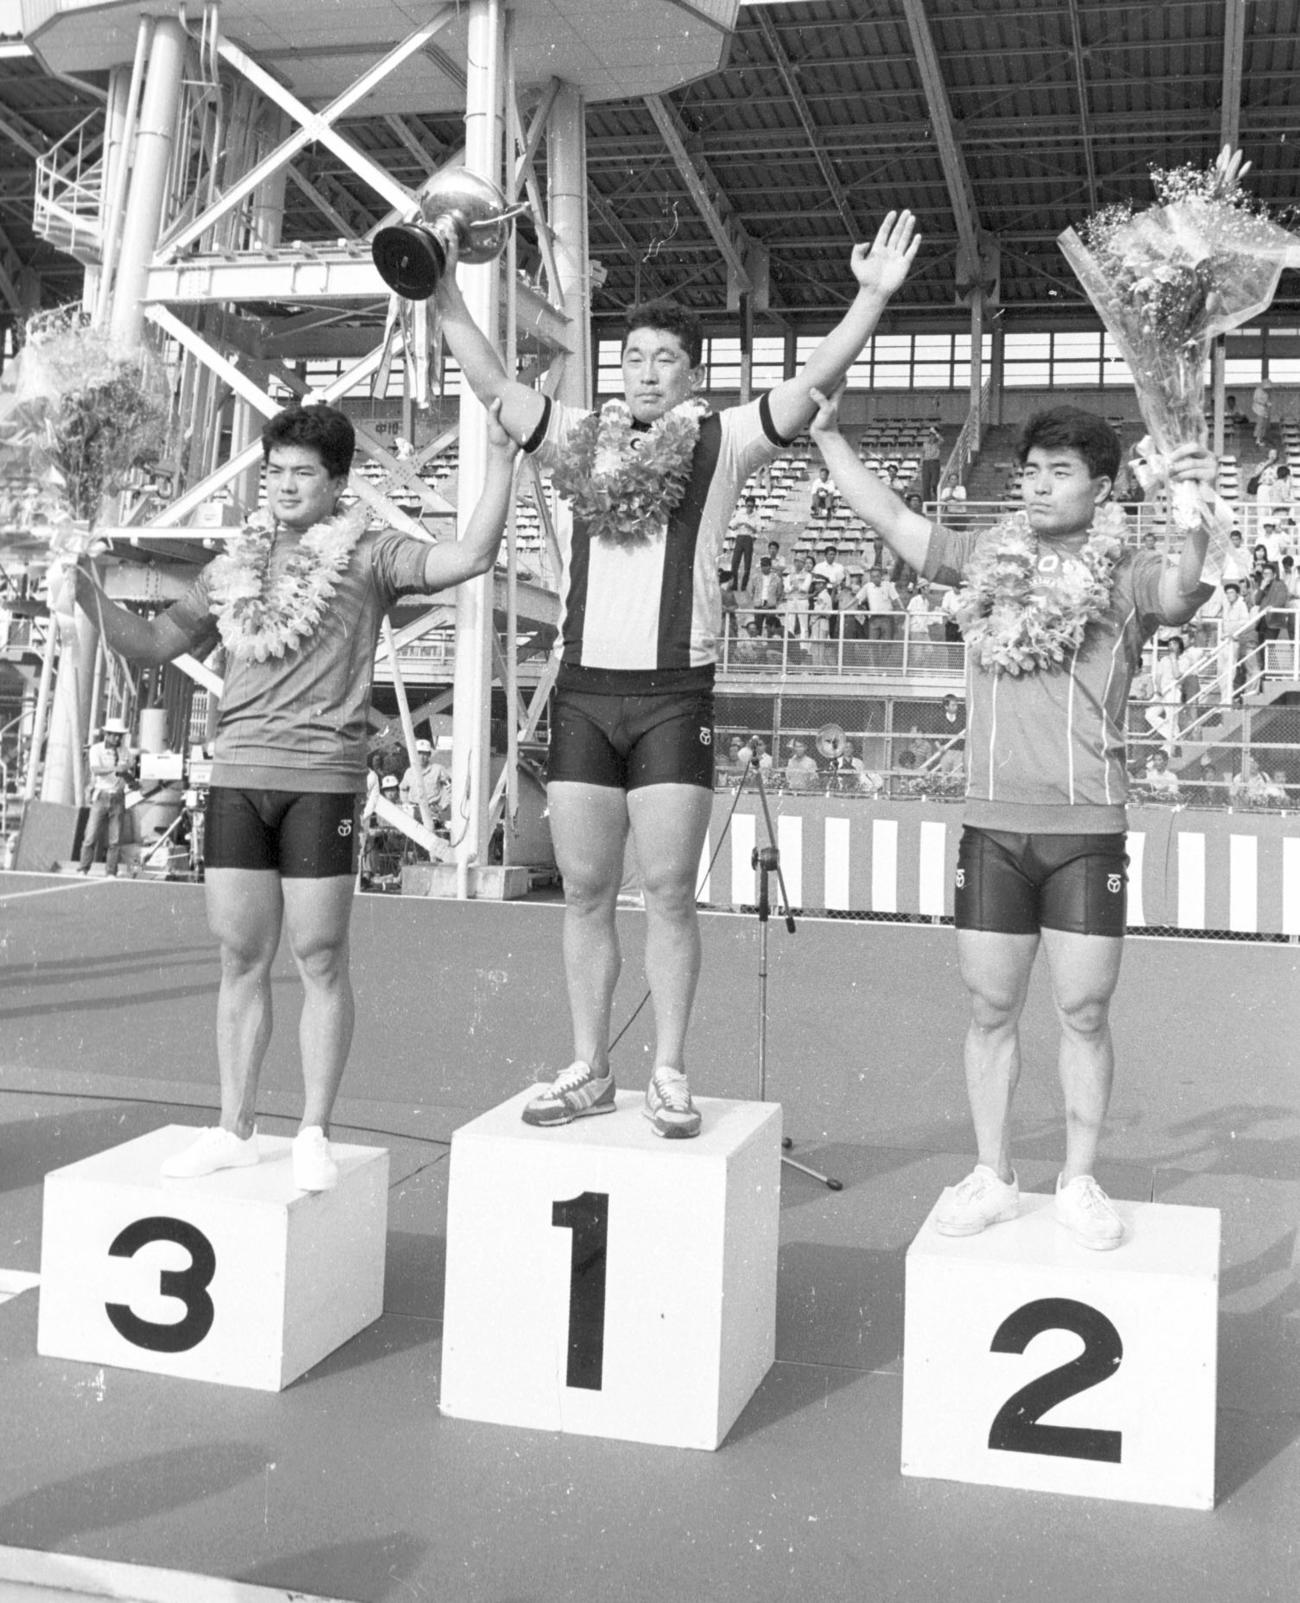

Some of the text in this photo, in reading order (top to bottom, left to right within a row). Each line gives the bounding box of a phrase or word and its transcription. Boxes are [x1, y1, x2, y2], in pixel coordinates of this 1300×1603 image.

[105, 1216, 216, 1353] 3
[553, 1192, 609, 1391] 1
[988, 1298, 1123, 1464] 2
